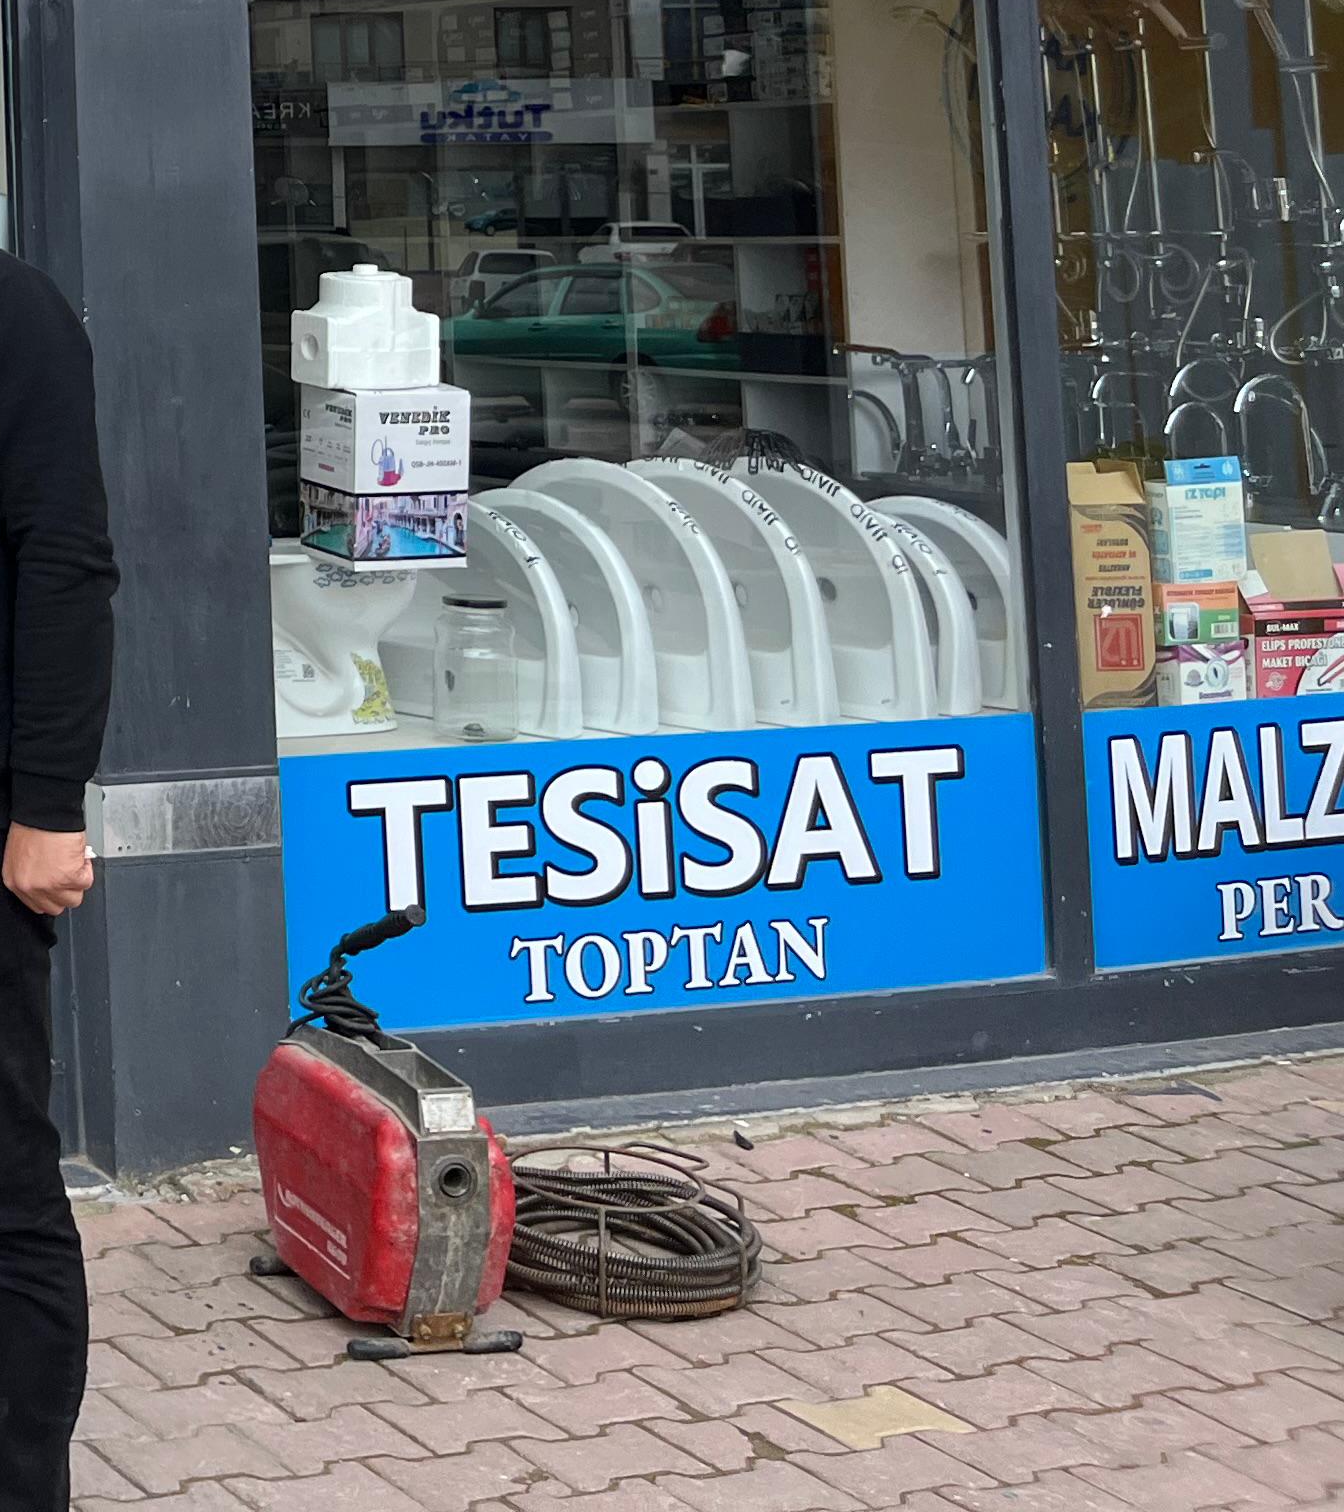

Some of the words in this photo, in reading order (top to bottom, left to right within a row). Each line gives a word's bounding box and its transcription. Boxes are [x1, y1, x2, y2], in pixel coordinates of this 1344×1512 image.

[418, 425, 451, 436] PRO
[1262, 655, 1293, 669] MAKET
[1109, 716, 1344, 865] MALZ
[1216, 874, 1344, 941] PER
[510, 917, 830, 1003] TOPTAN
